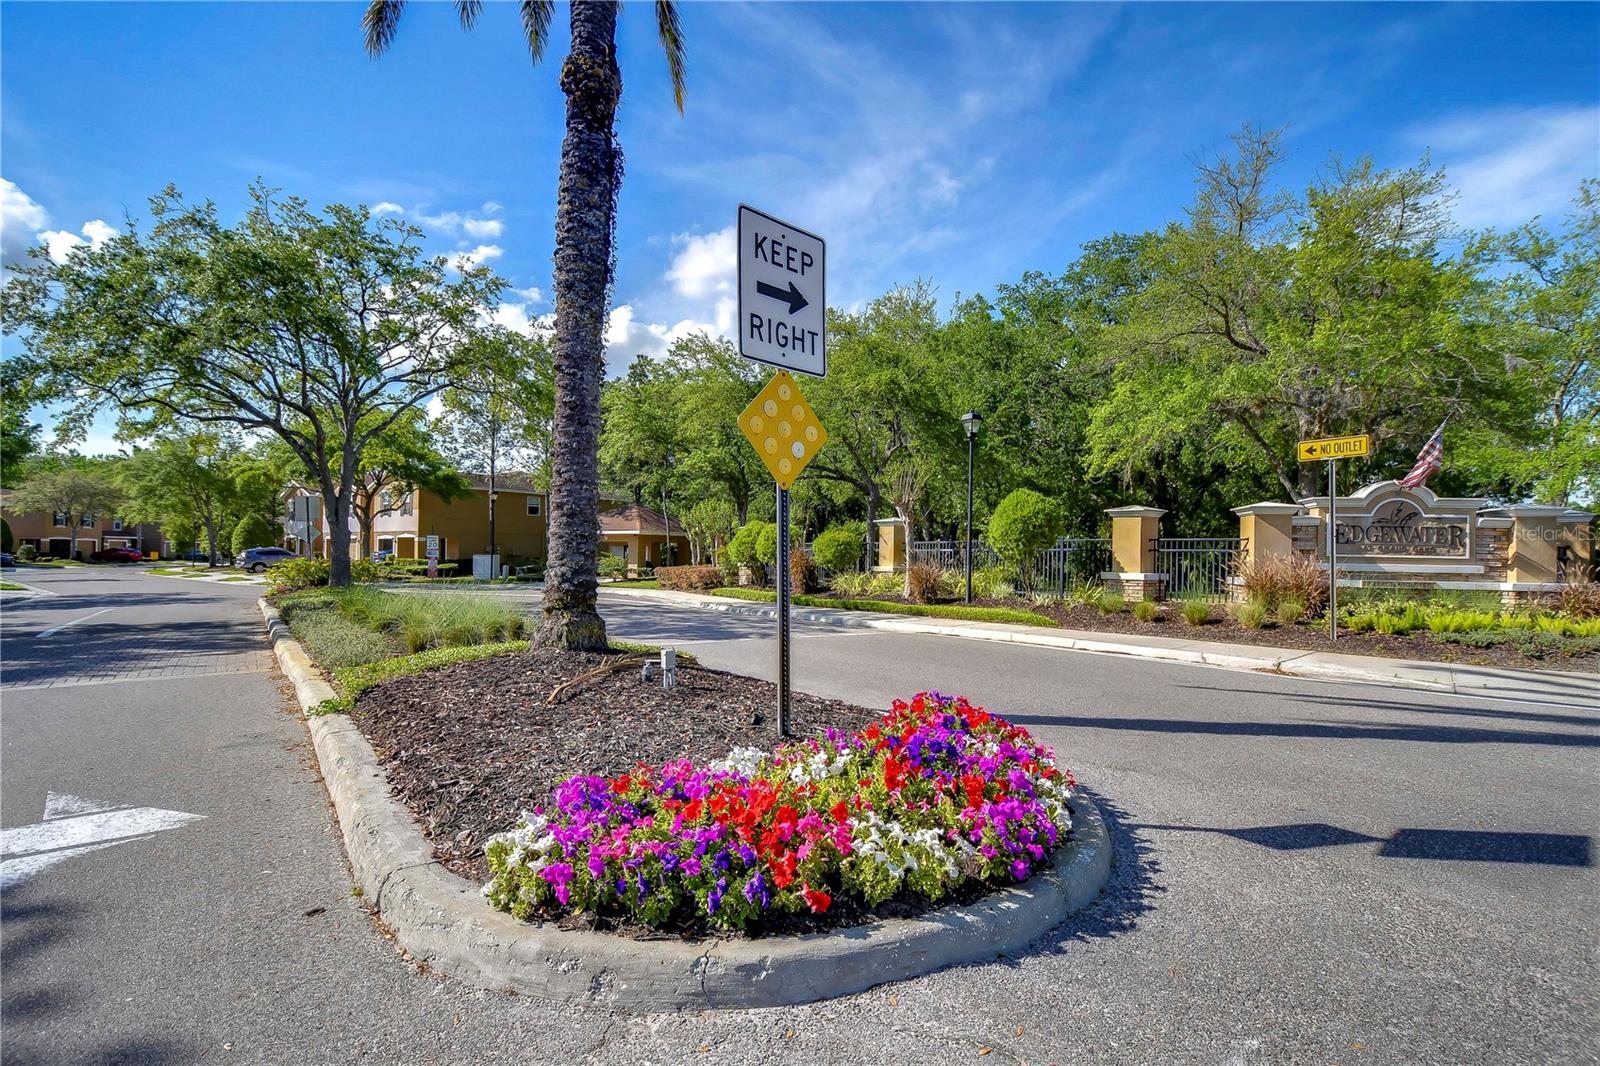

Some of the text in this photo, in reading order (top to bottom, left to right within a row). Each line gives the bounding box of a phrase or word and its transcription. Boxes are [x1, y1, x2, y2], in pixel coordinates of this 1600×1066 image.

[754, 232, 814, 276] KEEP
[750, 313, 818, 356] RIGHT
[1320, 440, 1362, 454] NO OUTLET
[1335, 523, 1465, 550] EDGEWATER
